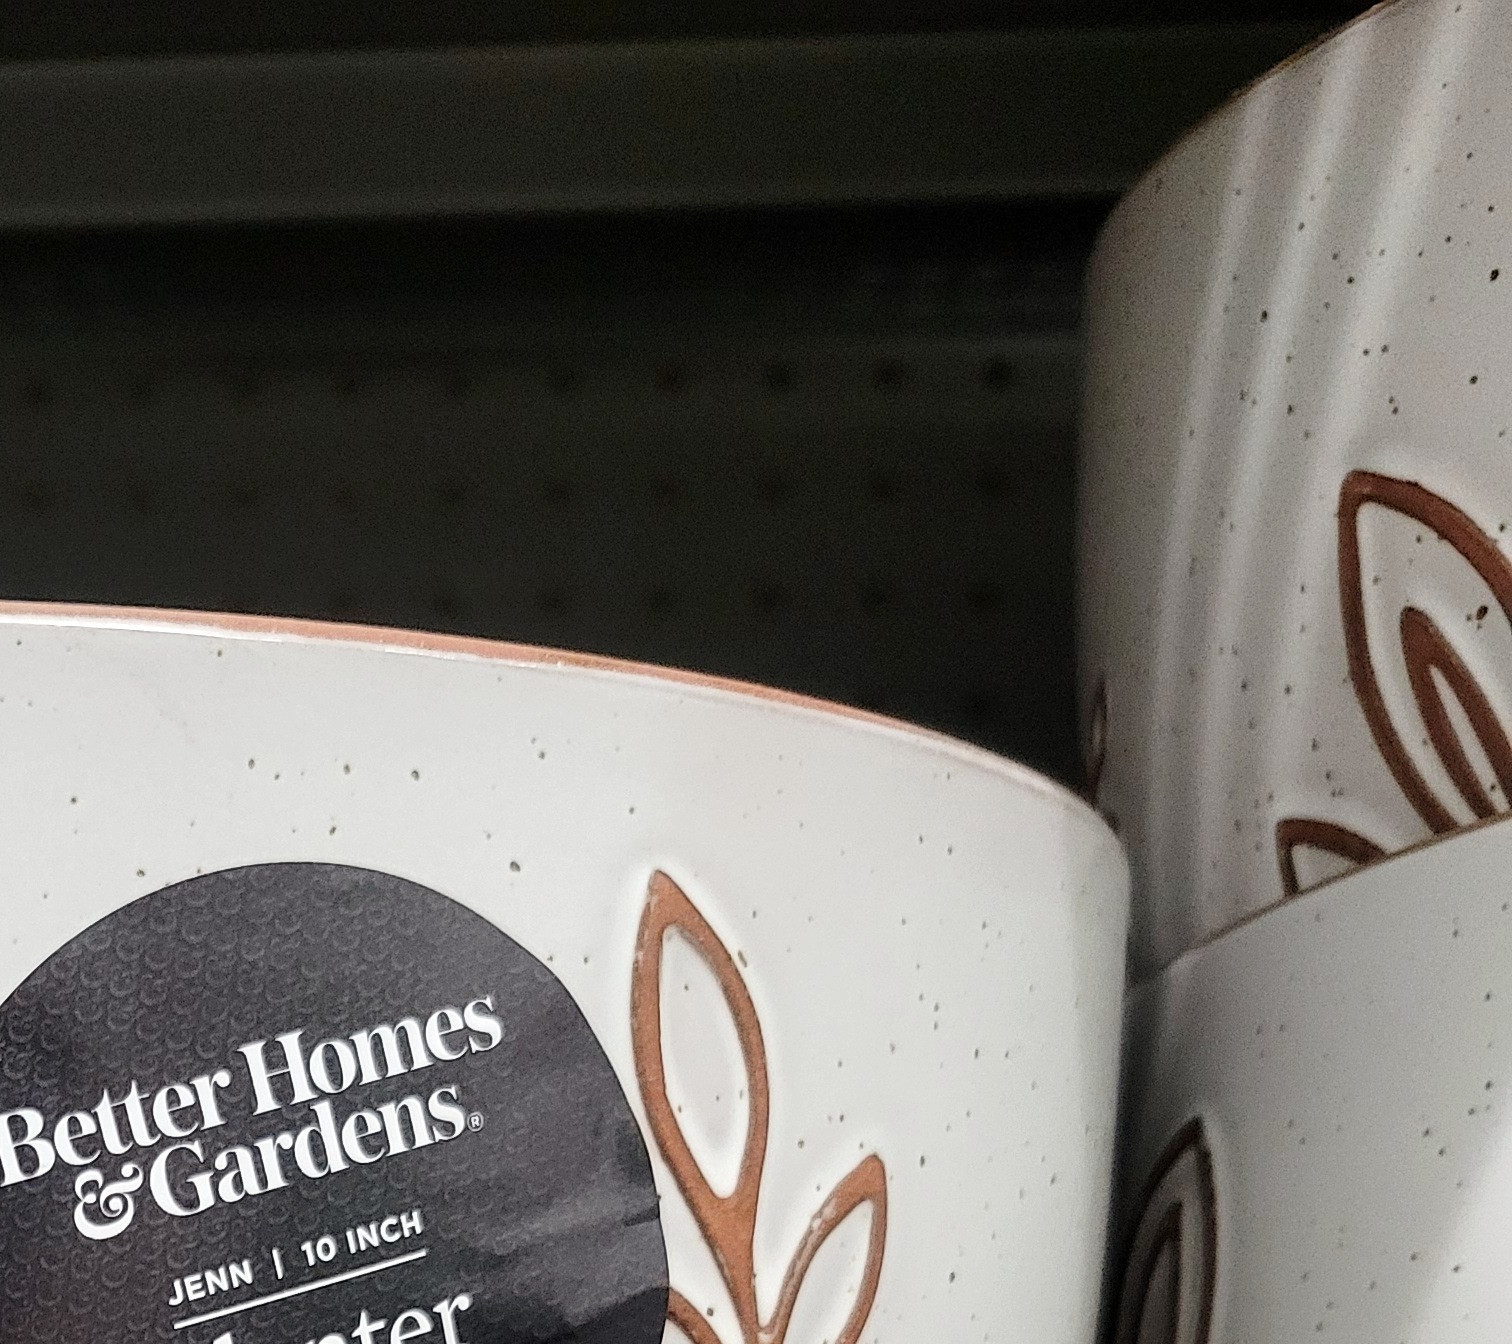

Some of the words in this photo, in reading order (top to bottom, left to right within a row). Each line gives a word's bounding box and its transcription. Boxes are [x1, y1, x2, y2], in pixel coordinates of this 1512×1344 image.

[236, 994, 504, 1116] Homes
[168, 1259, 253, 1306] JENN
[300, 1235, 337, 1267] 10
[345, 1210, 423, 1254] INCH
